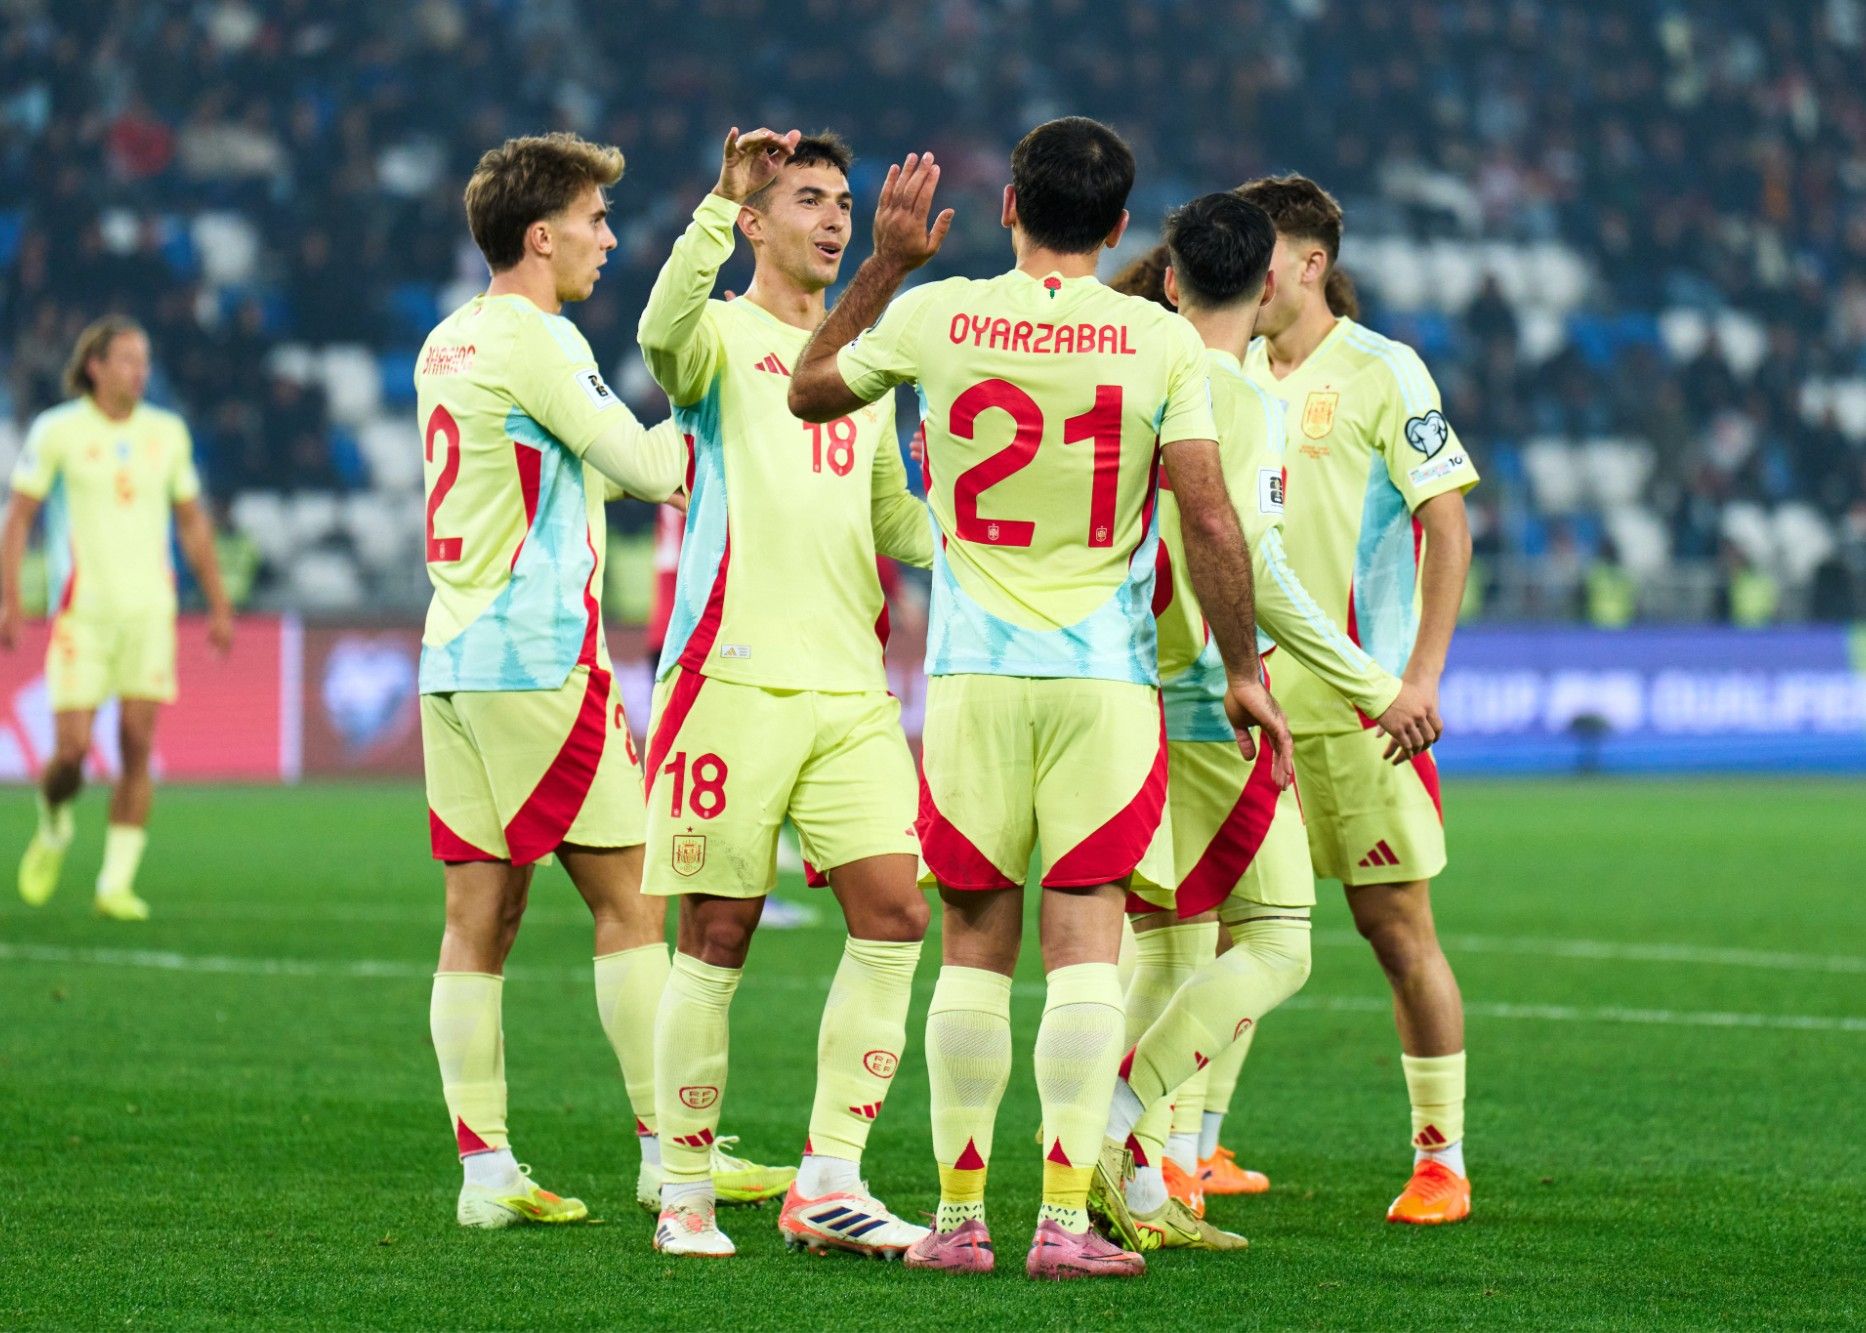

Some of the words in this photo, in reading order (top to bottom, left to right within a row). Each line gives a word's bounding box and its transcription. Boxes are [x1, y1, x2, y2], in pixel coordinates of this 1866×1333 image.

[949, 312, 1137, 354] OYARZABAL
[802, 414, 858, 477] 18
[949, 378, 1124, 549] 21
[425, 403, 463, 563] 2
[664, 751, 728, 819] 18
